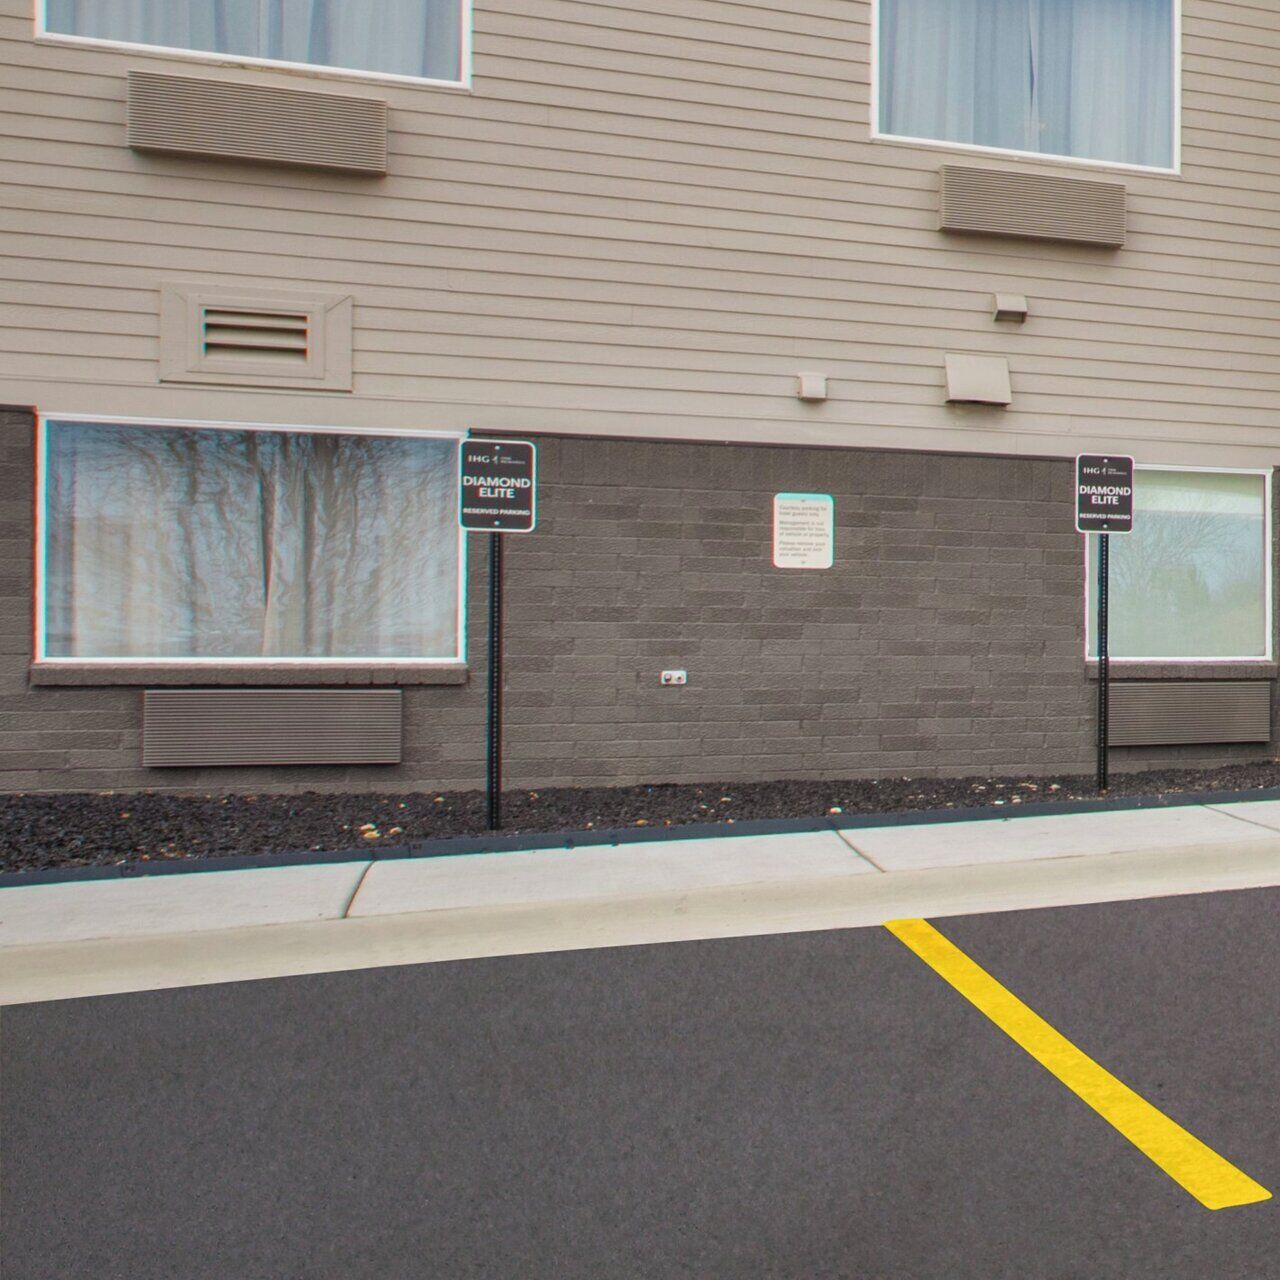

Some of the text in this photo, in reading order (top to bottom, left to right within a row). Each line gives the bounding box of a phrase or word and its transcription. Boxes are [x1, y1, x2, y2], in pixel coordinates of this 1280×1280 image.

[467, 454, 490, 463] IHG
[463, 476, 531, 488] DIAMOND
[479, 487, 515, 498] ELITE
[1079, 485, 1131, 496] DIAMOND
[1091, 496, 1119, 505] ELITE
